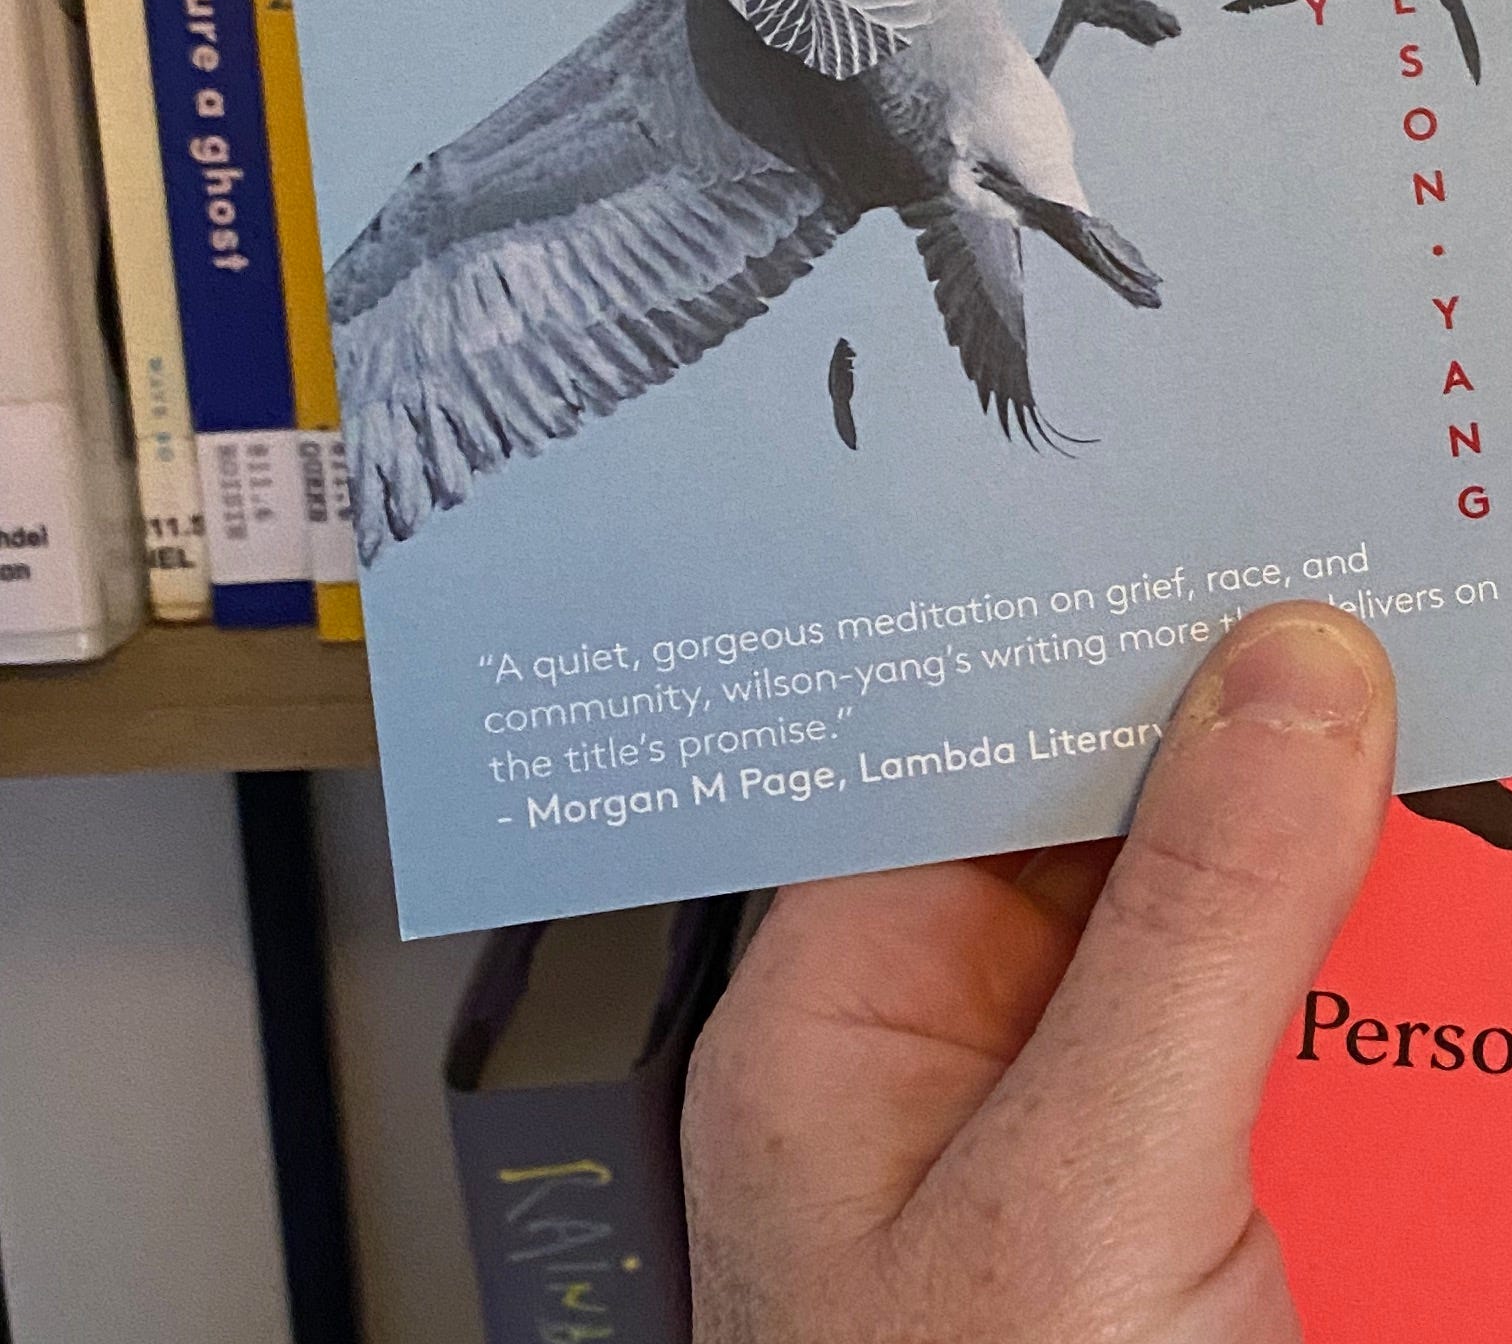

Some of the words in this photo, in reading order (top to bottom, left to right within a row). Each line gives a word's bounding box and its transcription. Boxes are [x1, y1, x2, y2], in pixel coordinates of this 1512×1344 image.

[195, 88, 226, 119] a
[188, 131, 250, 273] ghost
[484, 682, 711, 735] community,
[980, 630, 1105, 670] writing
[1119, 618, 1209, 653] more
[1455, 580, 1498, 605] on
[533, 642, 642, 685] quiet,
[652, 619, 825, 673] gorgeous
[838, 591, 1038, 639] meditation
[1050, 586, 1095, 612] on
[1107, 567, 1194, 610] grief,
[1207, 559, 1291, 593] race,
[1302, 542, 1369, 580] and
[489, 746, 552, 783] the
[527, 789, 678, 828] Morgan
[692, 775, 726, 805] M
[740, 766, 847, 803] Page,
[860, 735, 1015, 784] Lambda
